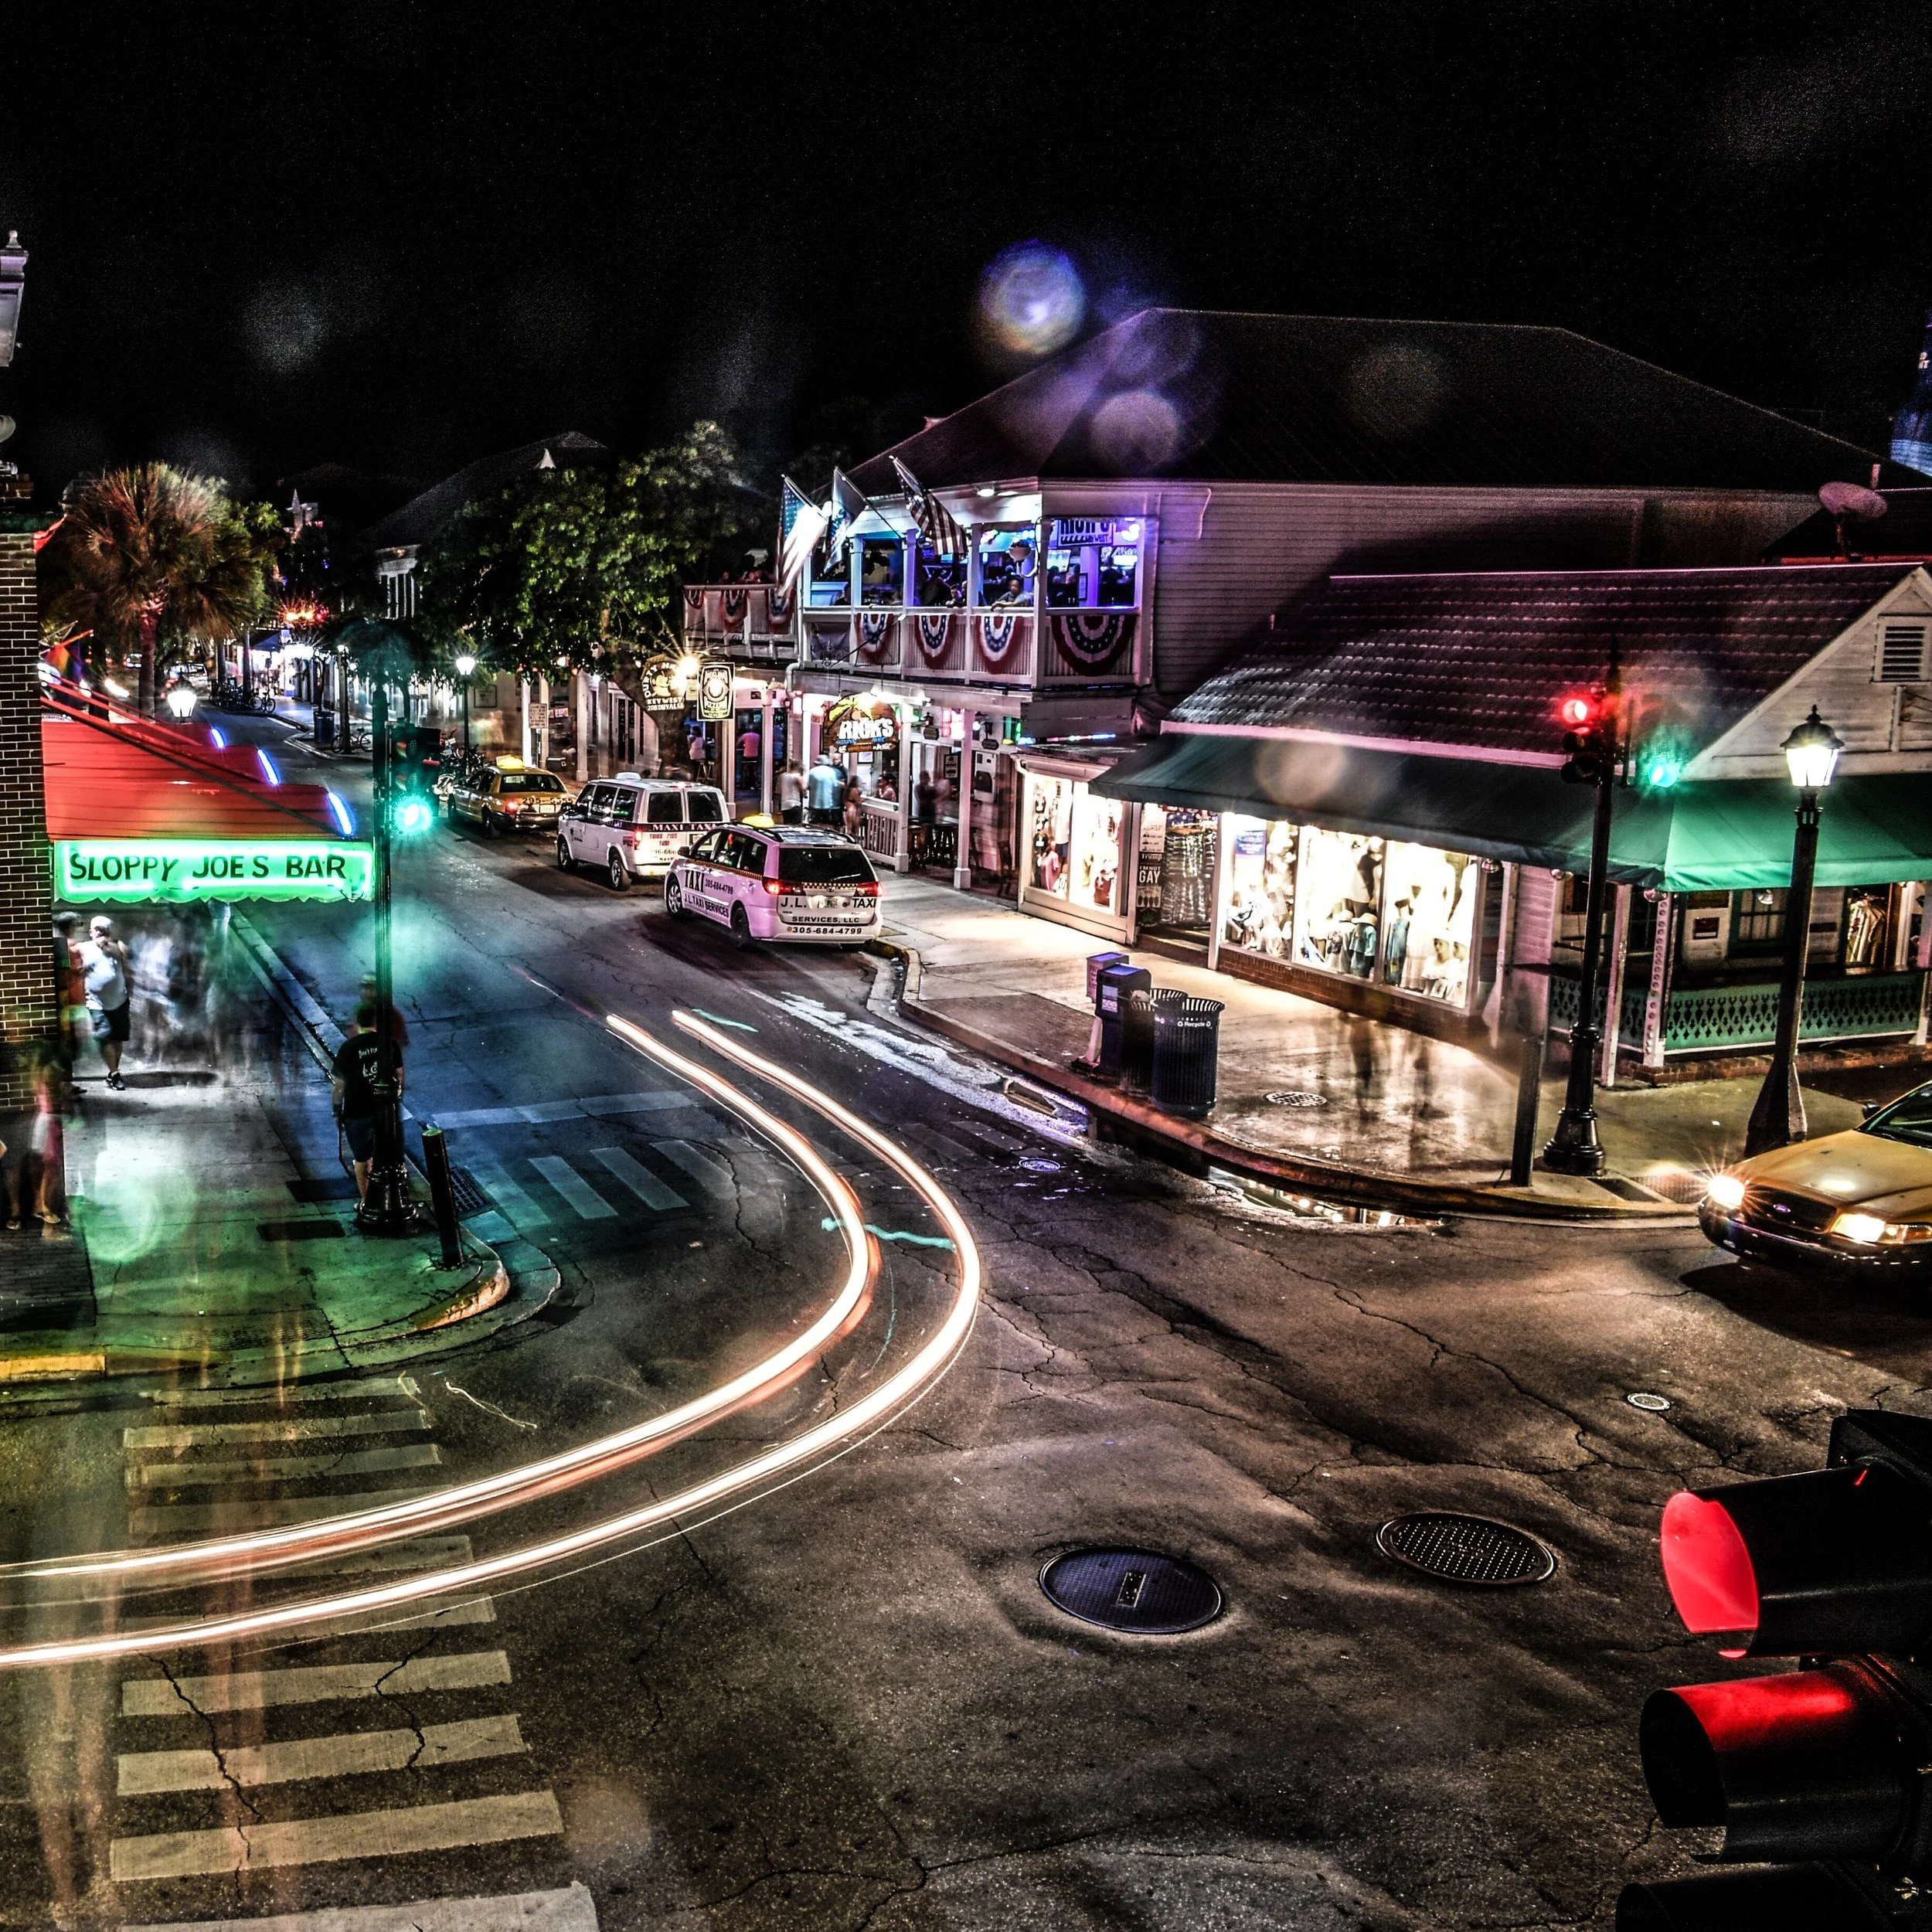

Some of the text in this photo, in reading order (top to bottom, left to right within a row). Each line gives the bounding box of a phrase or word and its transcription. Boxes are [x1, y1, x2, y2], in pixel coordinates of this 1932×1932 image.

[70, 853, 179, 882] SLOPPY
[286, 855, 347, 879] BAR
[685, 870, 705, 893] TAXI
[1139, 870, 1161, 884] GAY
[705, 879, 733, 894] 305-684-4799
[705, 901, 729, 918] SERVICES
[781, 897, 807, 908] J.L.
[852, 898, 876, 908] TAXI
